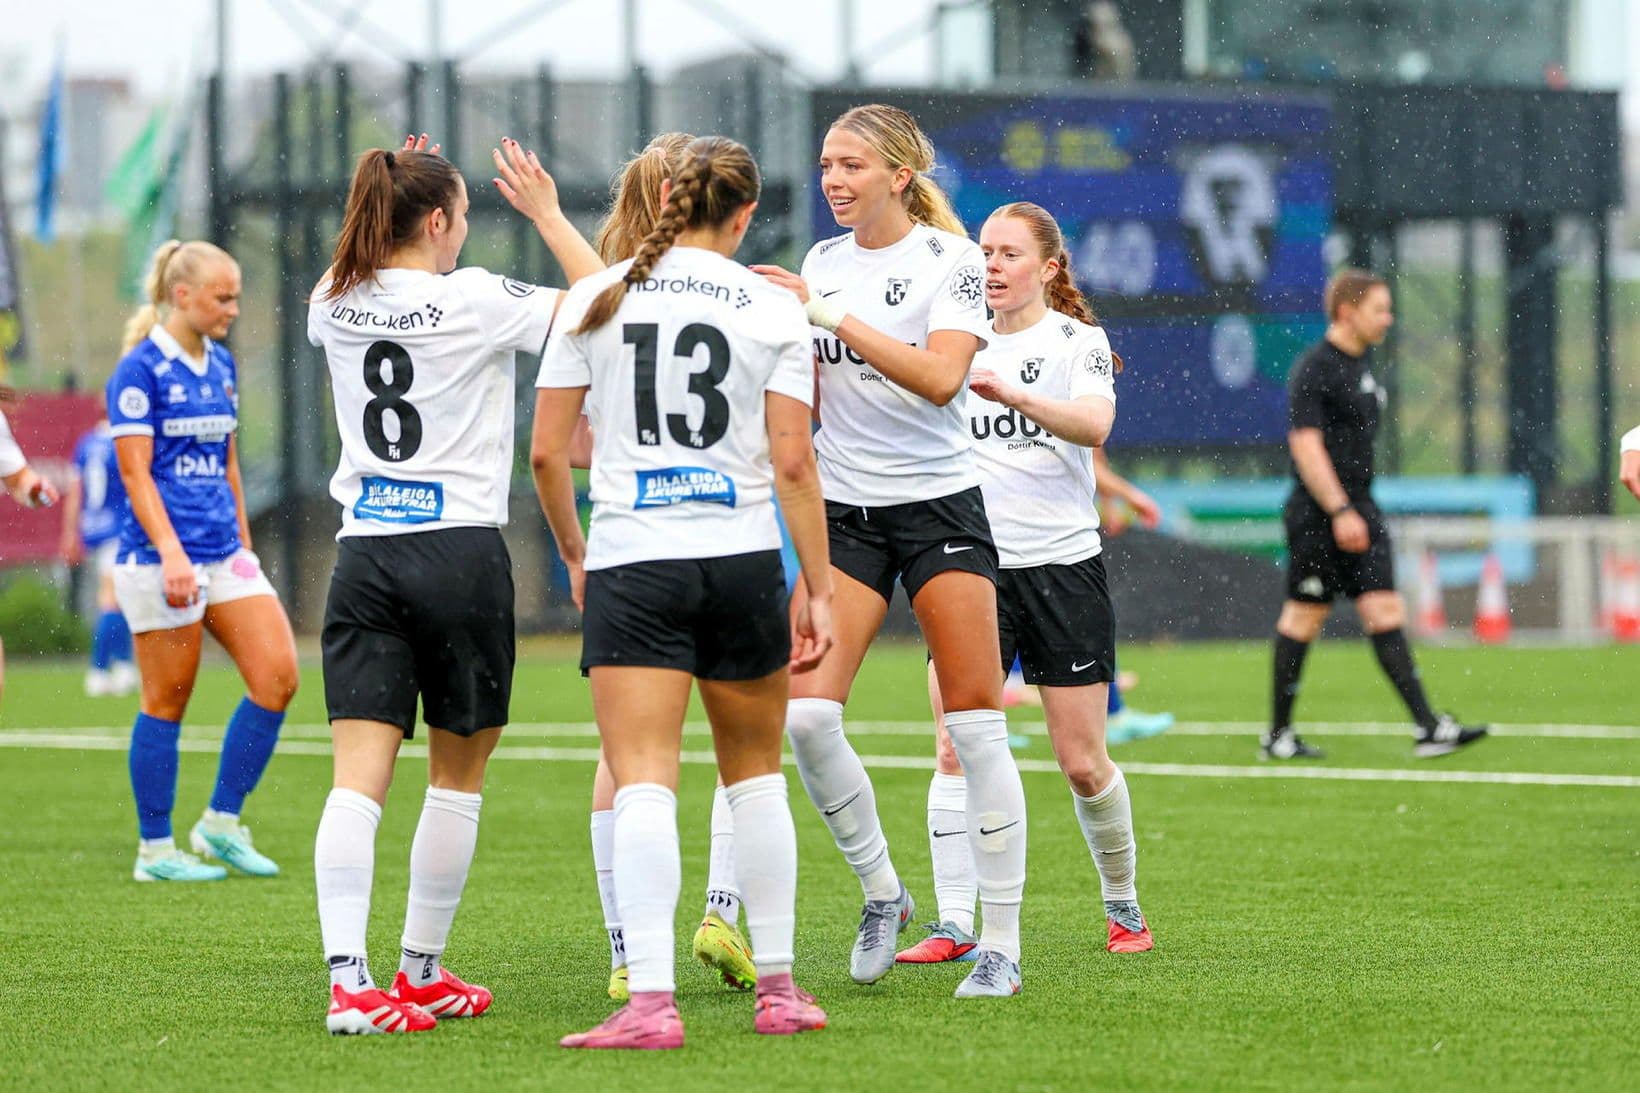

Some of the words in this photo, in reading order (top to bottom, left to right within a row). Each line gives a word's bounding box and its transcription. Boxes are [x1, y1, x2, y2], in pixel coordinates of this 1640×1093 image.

[331, 303, 424, 330] unbroken
[362, 340, 423, 463] 8
[623, 322, 731, 451] 13
